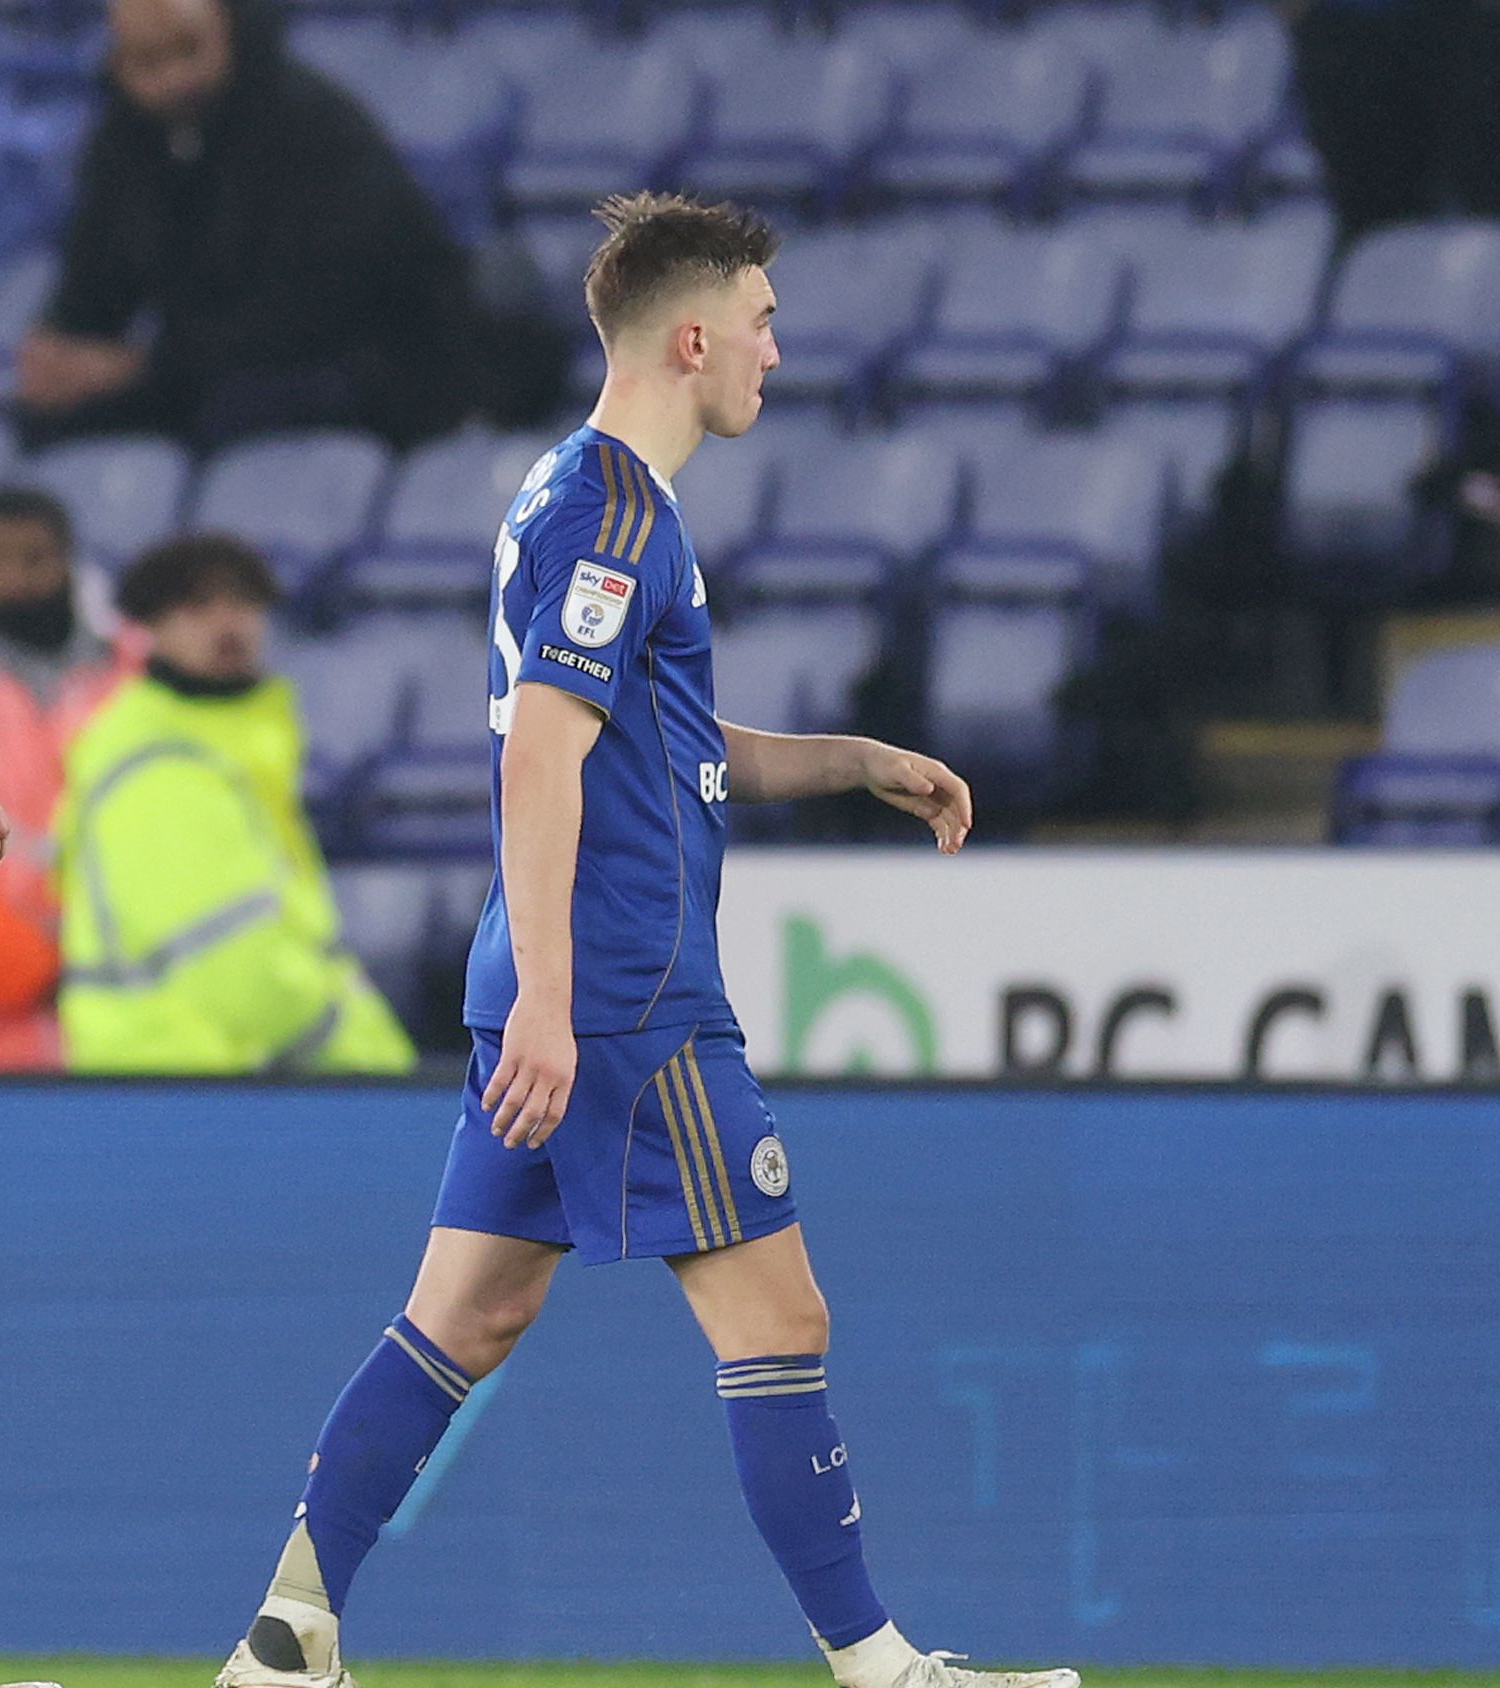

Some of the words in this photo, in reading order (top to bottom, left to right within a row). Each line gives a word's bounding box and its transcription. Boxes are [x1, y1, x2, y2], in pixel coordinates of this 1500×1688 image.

[580, 571, 602, 586] sky
[577, 625, 596, 639] EFL
[540, 645, 612, 682] TOGETHER
[699, 761, 728, 803] BC
